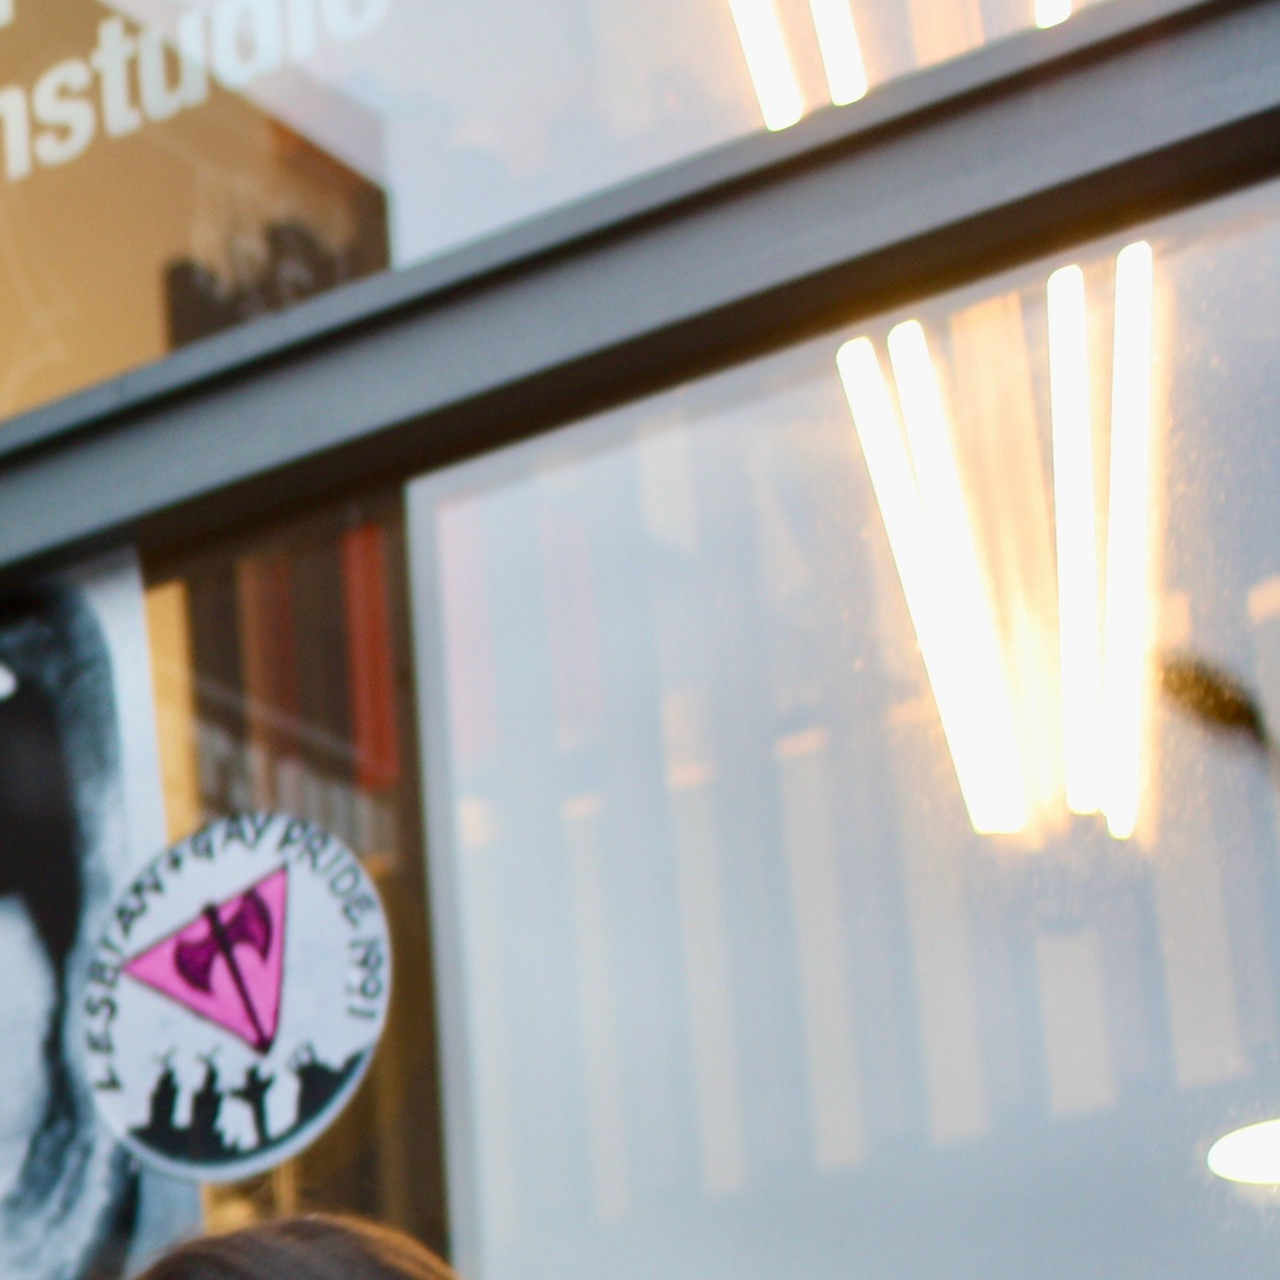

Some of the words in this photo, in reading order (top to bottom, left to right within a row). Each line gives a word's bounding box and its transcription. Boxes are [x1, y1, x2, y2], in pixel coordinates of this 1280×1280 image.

[84, 855, 164, 1094] LESBIAN
[190, 812, 274, 861] GAY
[278, 816, 376, 928] PRIDE
